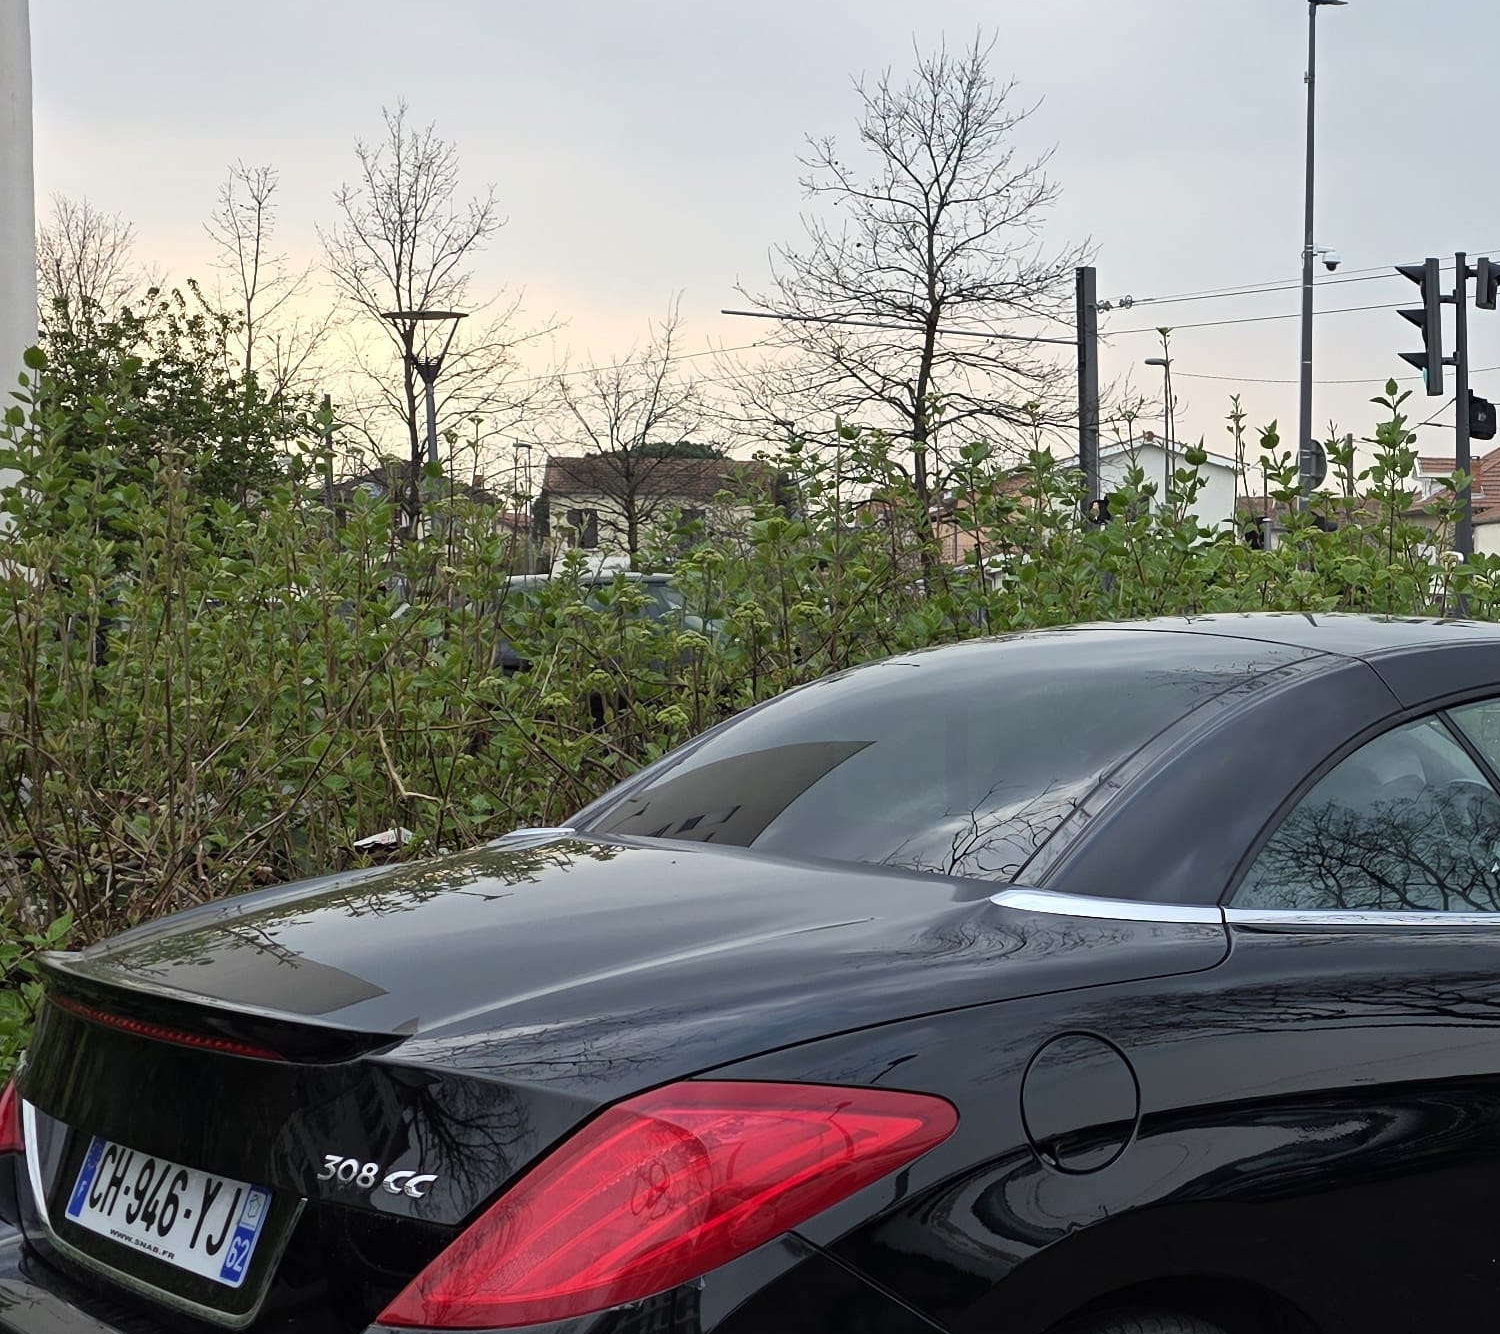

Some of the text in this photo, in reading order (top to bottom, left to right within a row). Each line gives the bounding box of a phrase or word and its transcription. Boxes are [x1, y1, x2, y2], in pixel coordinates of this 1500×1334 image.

[317, 1154, 439, 1198] 308 CC
[88, 1144, 242, 1256] CH-946-YJ
[225, 1236, 250, 1272] 62
